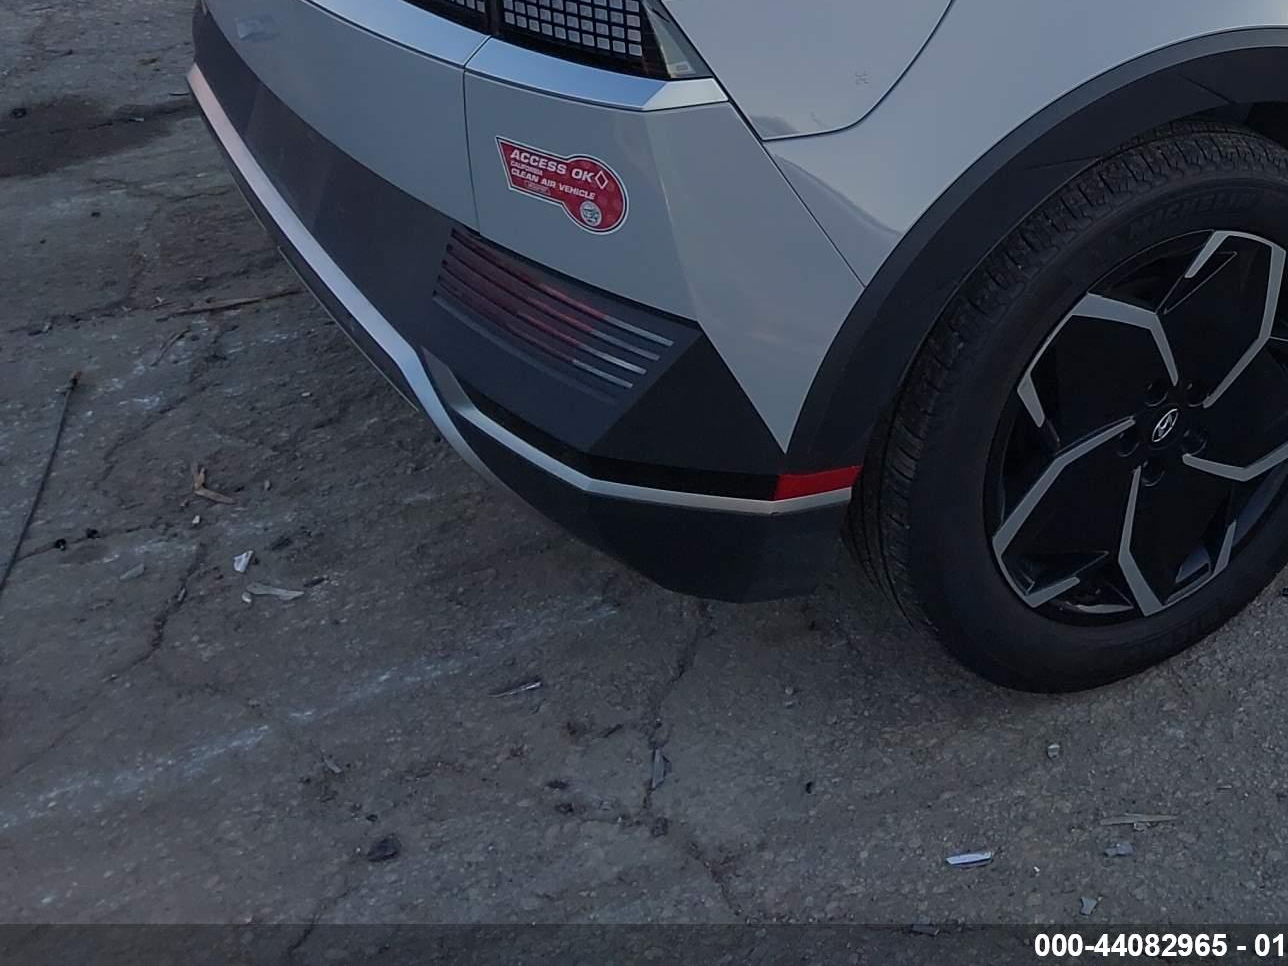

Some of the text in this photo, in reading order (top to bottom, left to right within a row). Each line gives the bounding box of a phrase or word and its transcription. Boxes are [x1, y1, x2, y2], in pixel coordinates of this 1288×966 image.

[510, 149, 595, 183] ACCESS OK
[511, 168, 539, 182] CLEAN
[541, 177, 556, 189] AIR
[559, 183, 596, 200] VEHICLE
